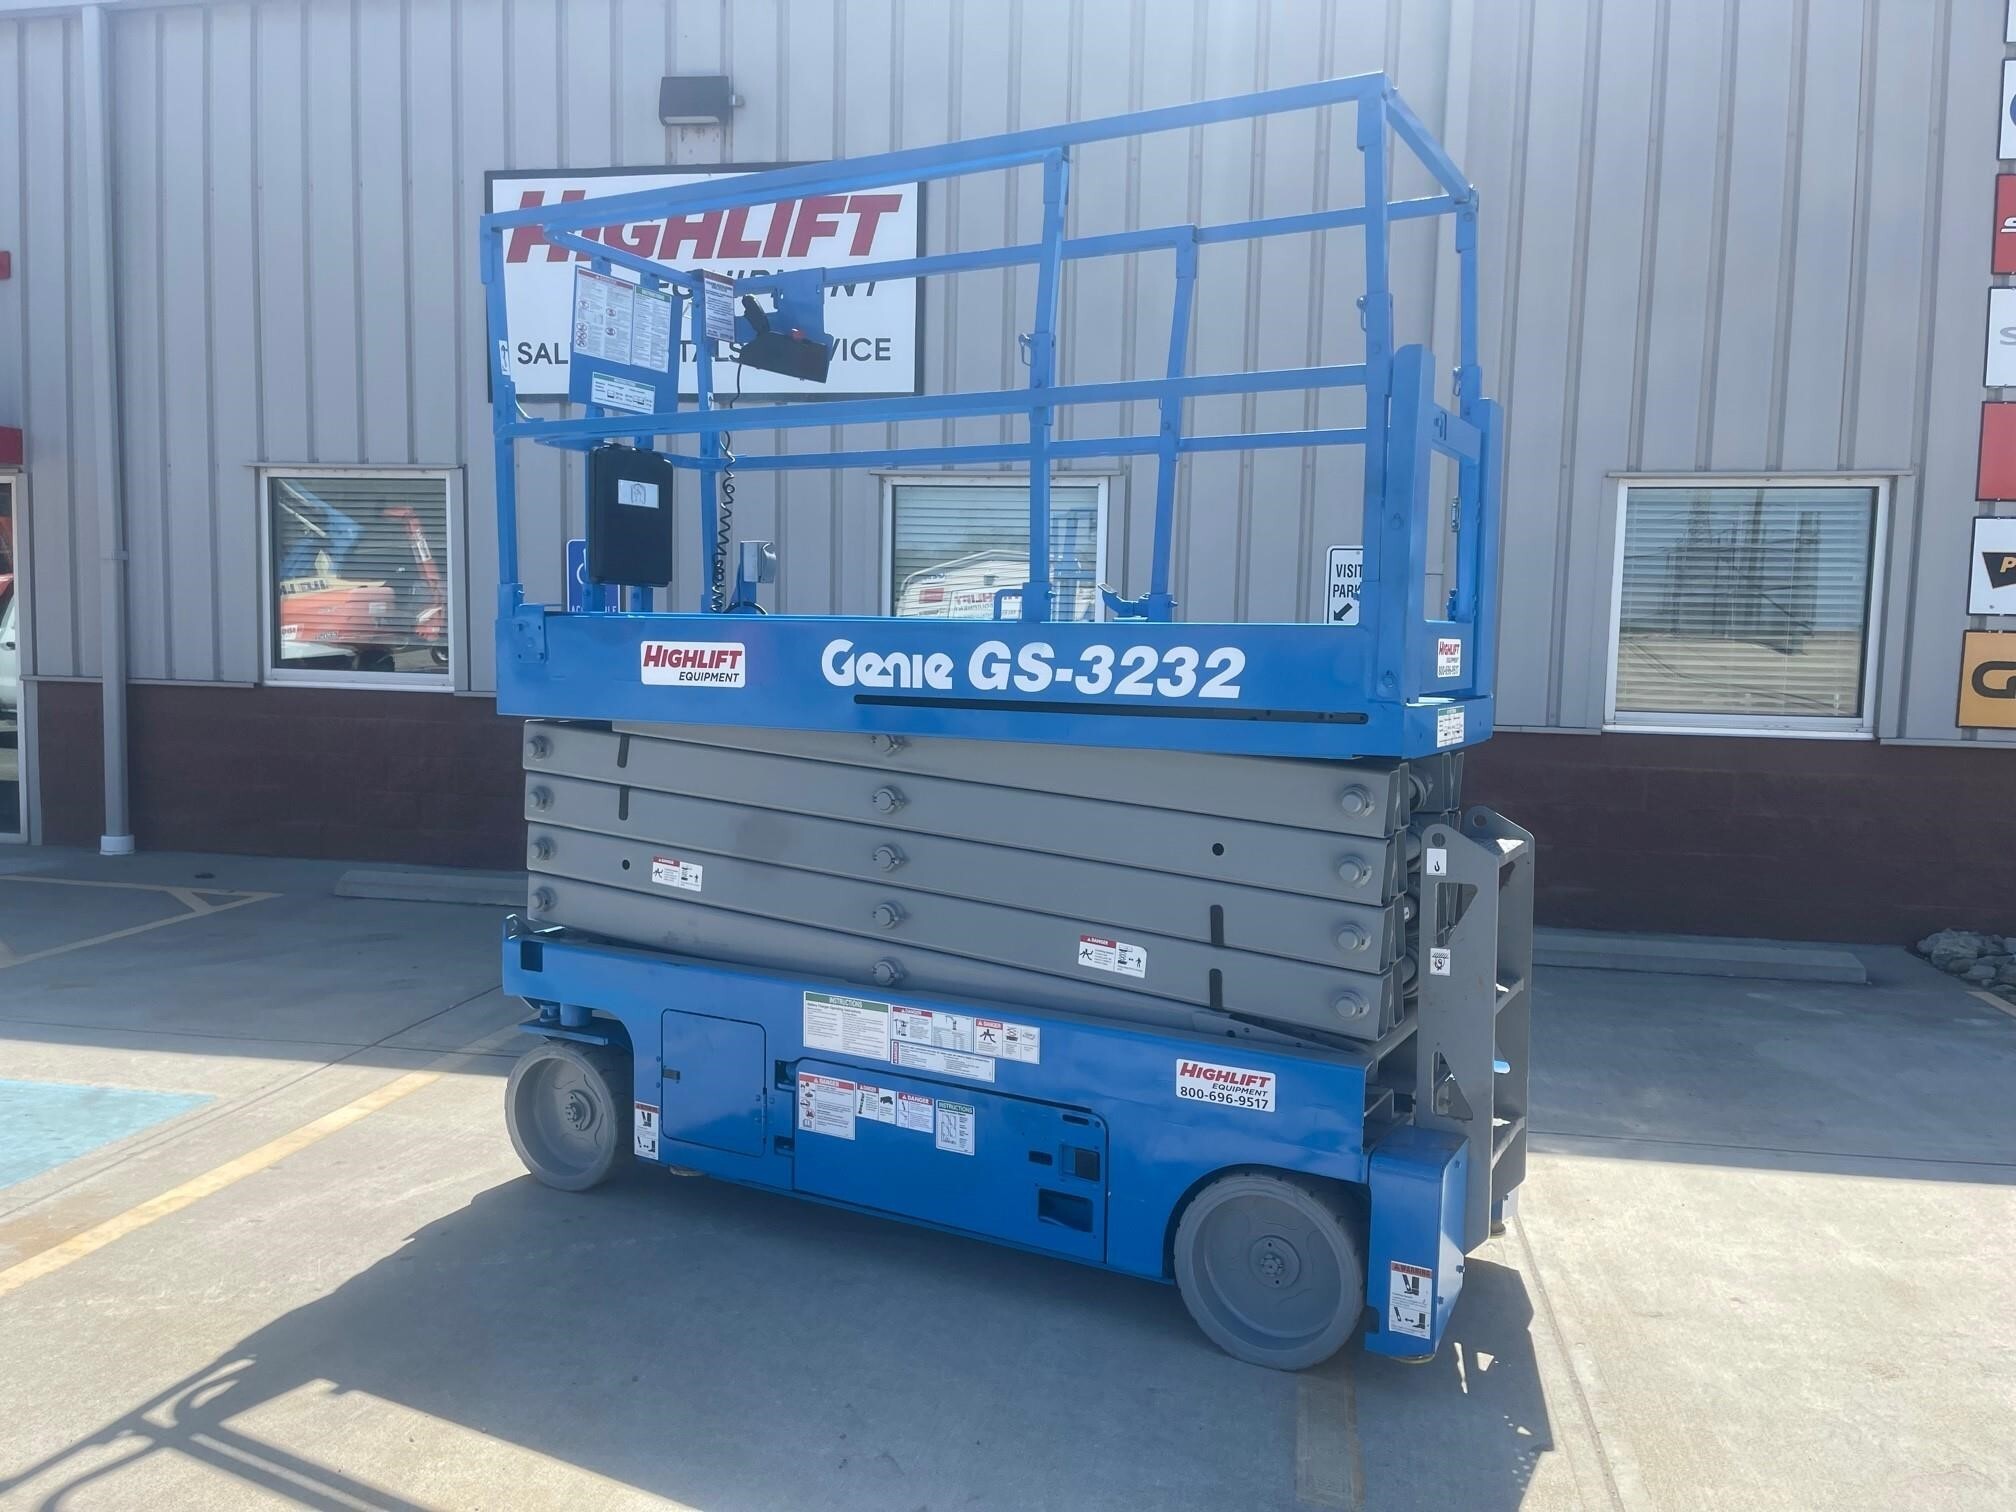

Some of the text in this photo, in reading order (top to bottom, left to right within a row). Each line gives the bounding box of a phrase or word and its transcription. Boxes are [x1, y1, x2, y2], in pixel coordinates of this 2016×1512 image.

[643, 644, 743, 669] HIGHLIFT
[821, 638, 1247, 699] Genie GS-3232
[678, 671, 740, 683] EQUIPMENT
[1180, 1062, 1271, 1088] HIGHLIFT
[1180, 1086, 1269, 1110] 800-696-9517
[1212, 1082, 1268, 1097] EQUIPMENT
